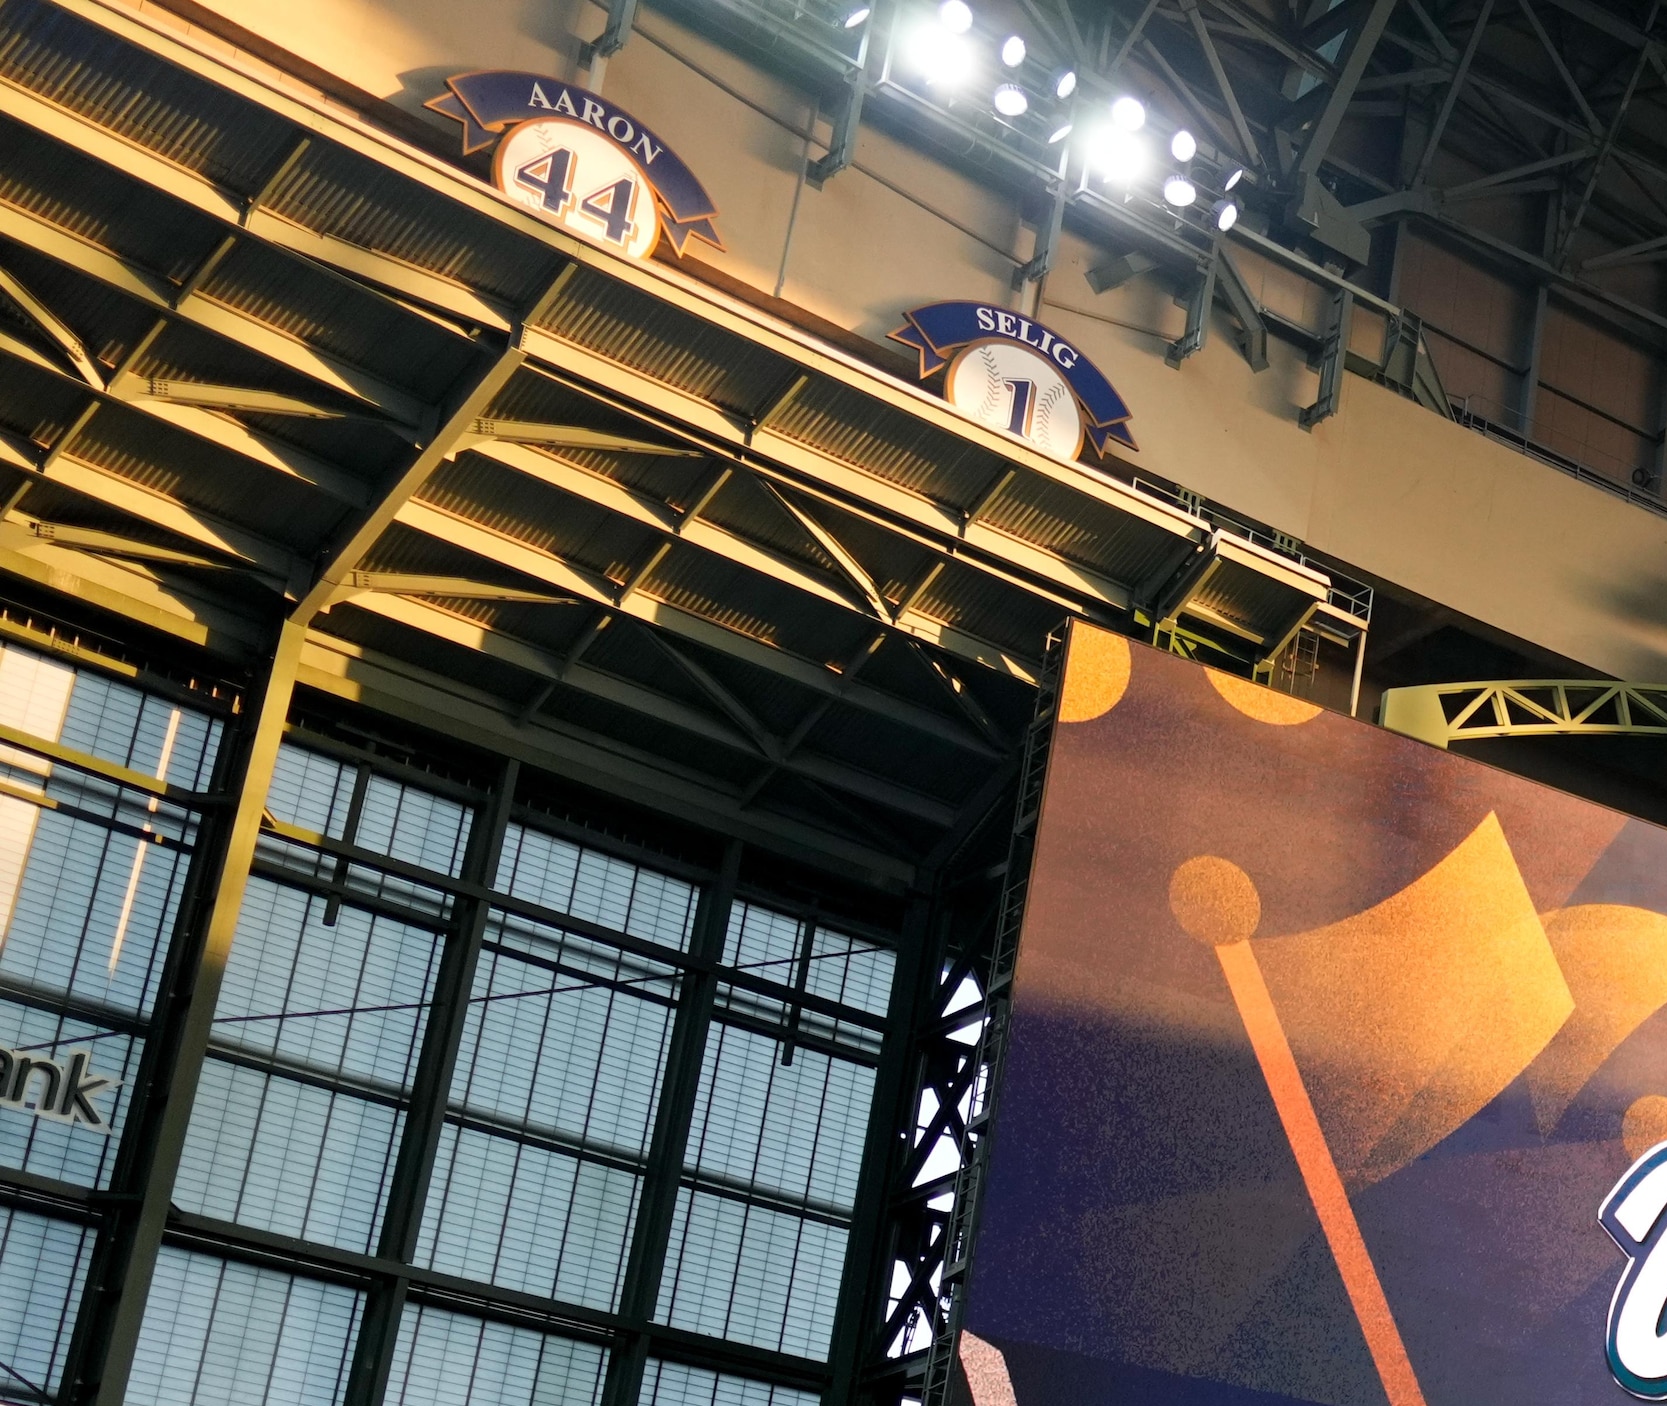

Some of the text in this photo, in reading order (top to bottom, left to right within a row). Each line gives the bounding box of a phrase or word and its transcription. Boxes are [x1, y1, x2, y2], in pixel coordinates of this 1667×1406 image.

[528, 82, 663, 165] AARON
[514, 145, 639, 252] 44
[976, 307, 1079, 370] SELIG
[1000, 377, 1037, 441] 1
